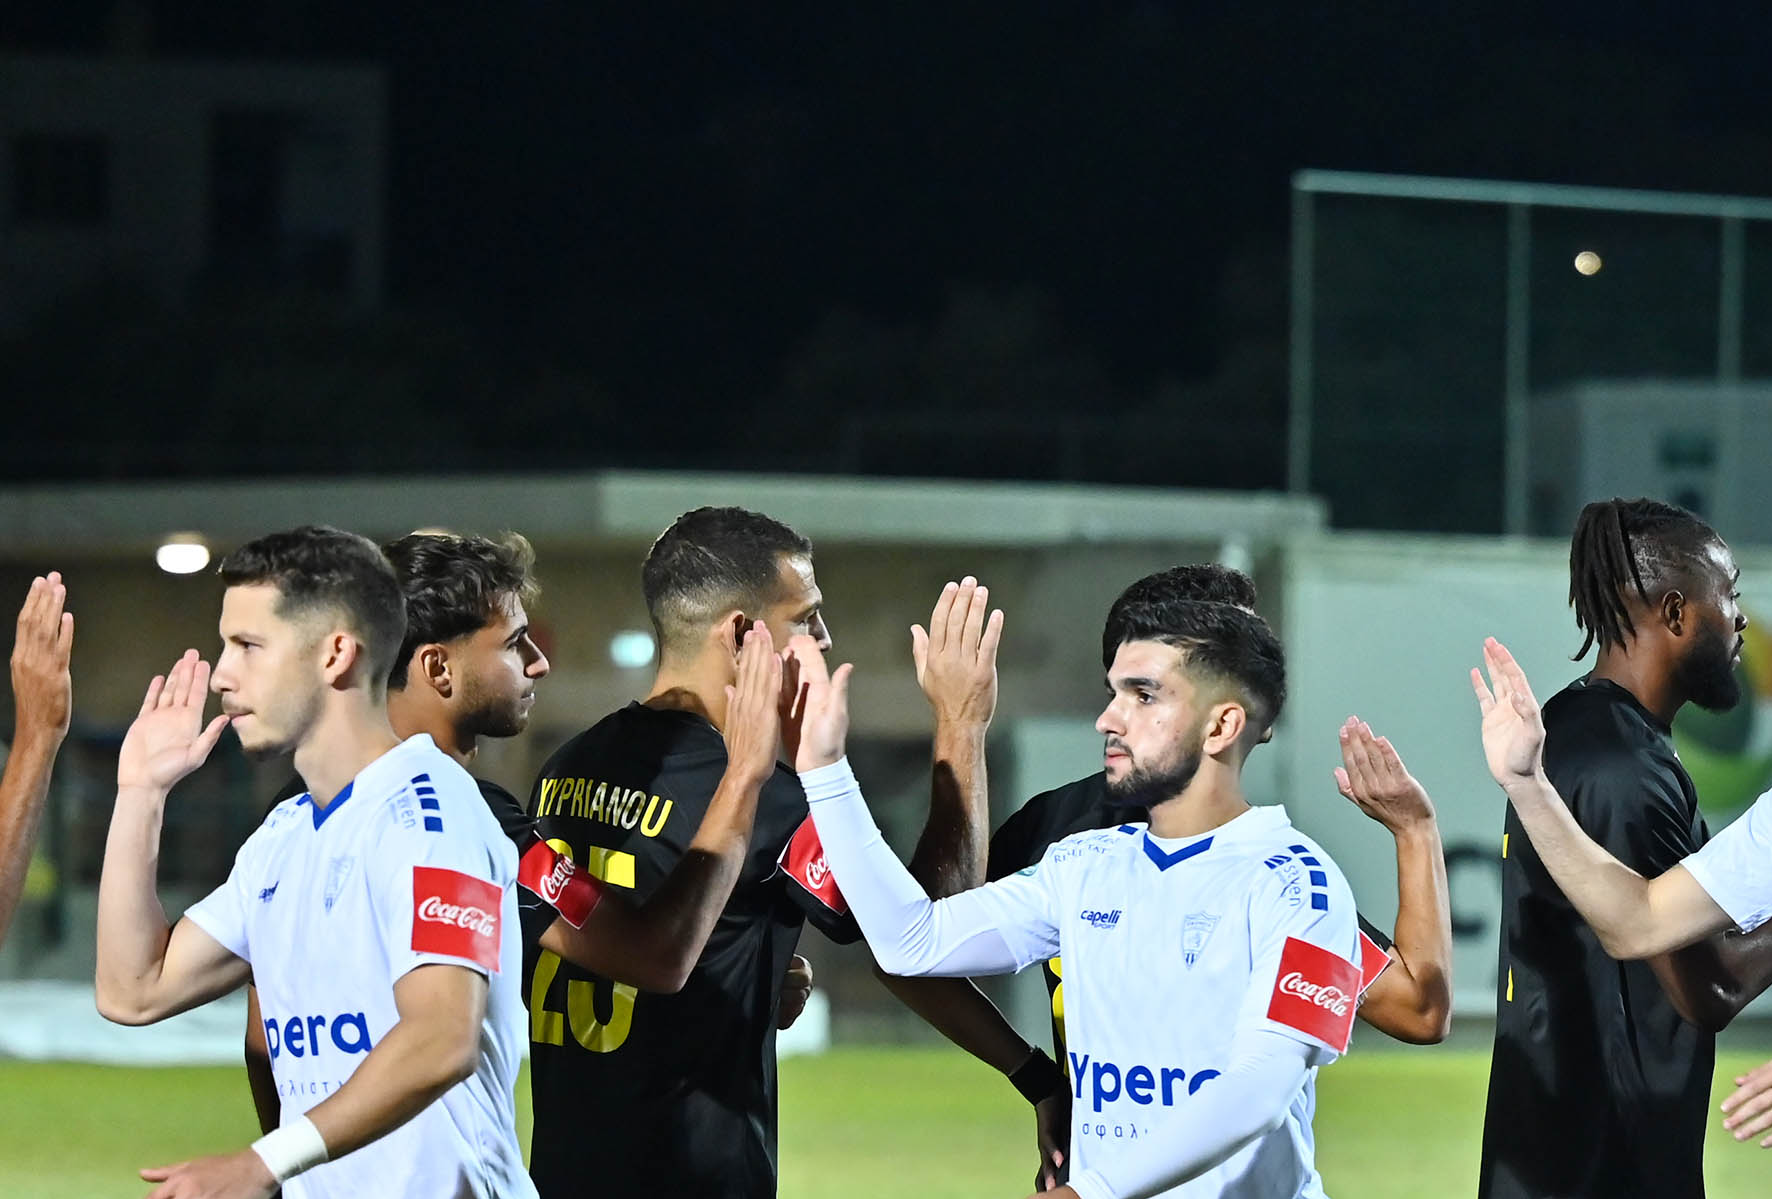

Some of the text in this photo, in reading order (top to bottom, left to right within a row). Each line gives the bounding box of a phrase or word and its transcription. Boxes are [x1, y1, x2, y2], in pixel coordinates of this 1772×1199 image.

[417, 895, 499, 938] Coca-Cola
[1080, 909, 1122, 926] capelli
[1278, 971, 1355, 1018] Coca-Cola
